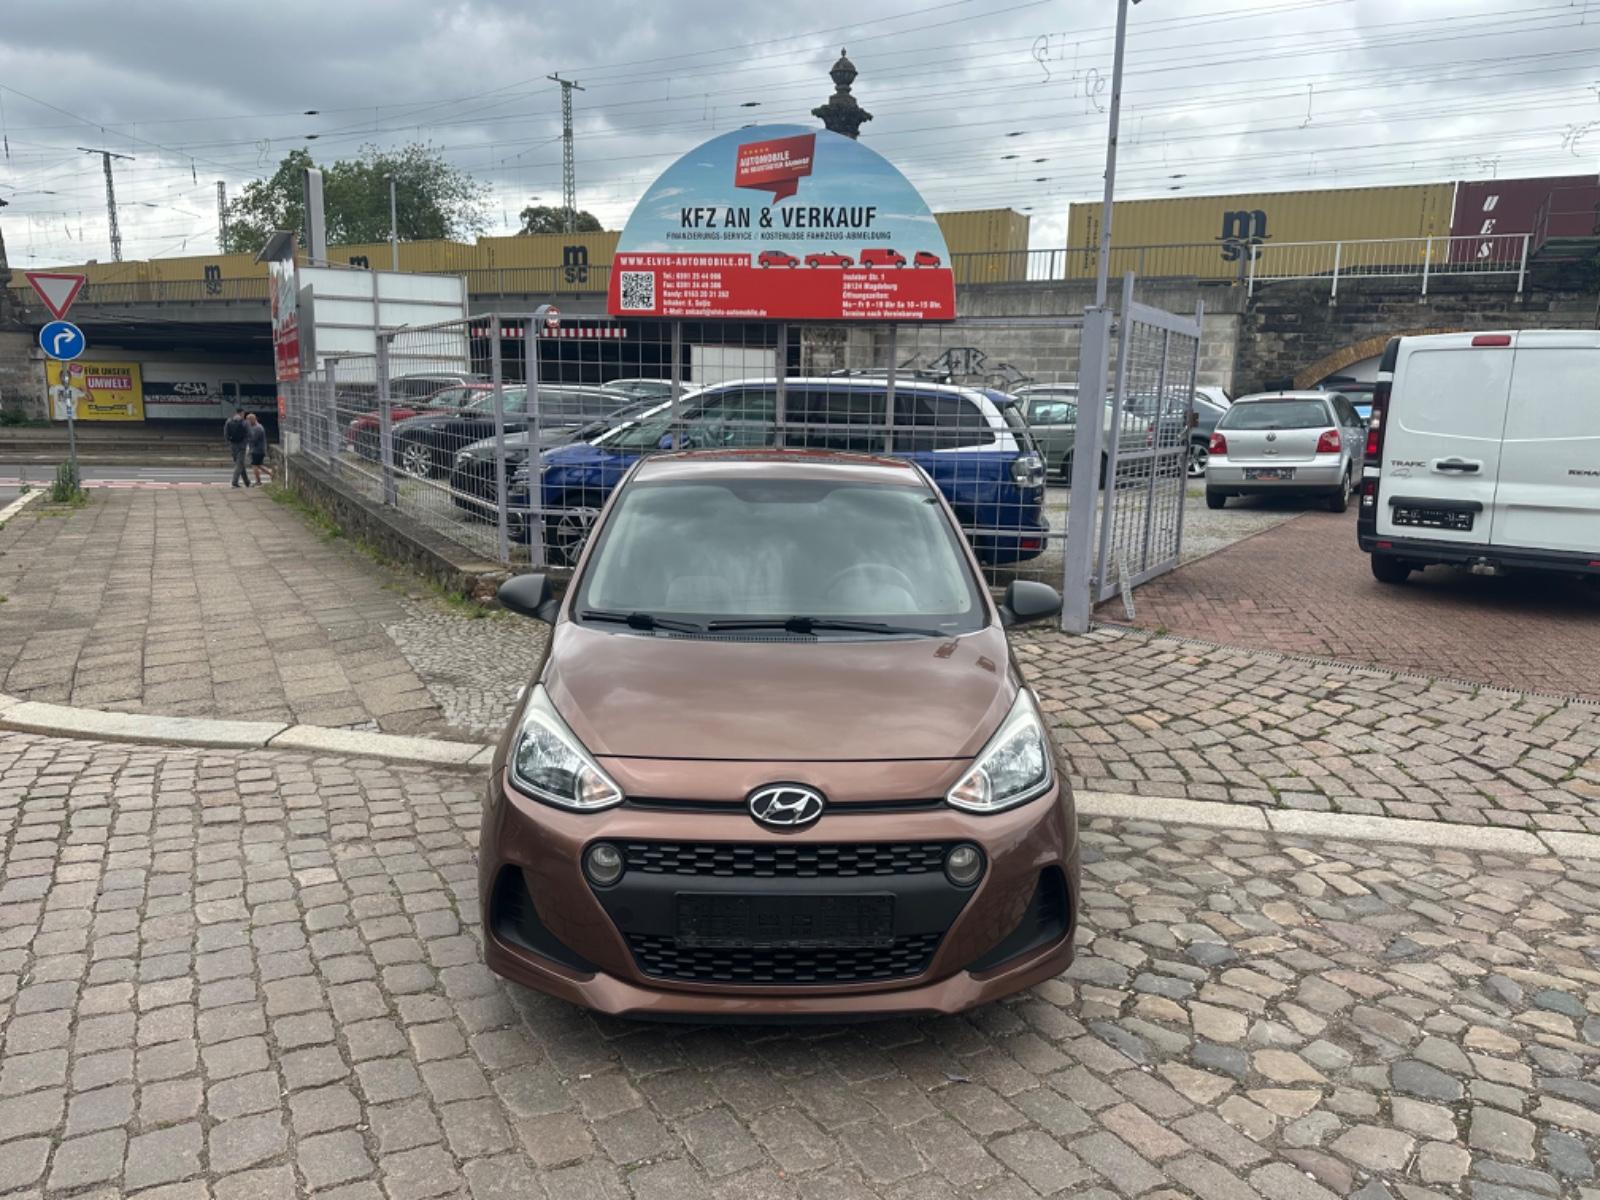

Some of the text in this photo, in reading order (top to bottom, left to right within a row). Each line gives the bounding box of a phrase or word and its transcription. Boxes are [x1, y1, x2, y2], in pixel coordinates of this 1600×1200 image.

[740, 150, 790, 168] AUTOMOBILE
[681, 206, 876, 228] KFZ AN & VERKAUF
[666, 231, 752, 240] FINANZIERUNGS-SERVICE
[761, 231, 804, 240] KOSTENLOSE
[806, 231, 891, 240] FAHRZEUG-ABMELDUNG
[620, 257, 749, 266] WWW.ELVIS-AUTOMOBILE.DE
[84, 366, 131, 375] FÜR UNSERE
[88, 377, 131, 389] UMWELT.
[1391, 460, 1426, 468] TRAFIC
